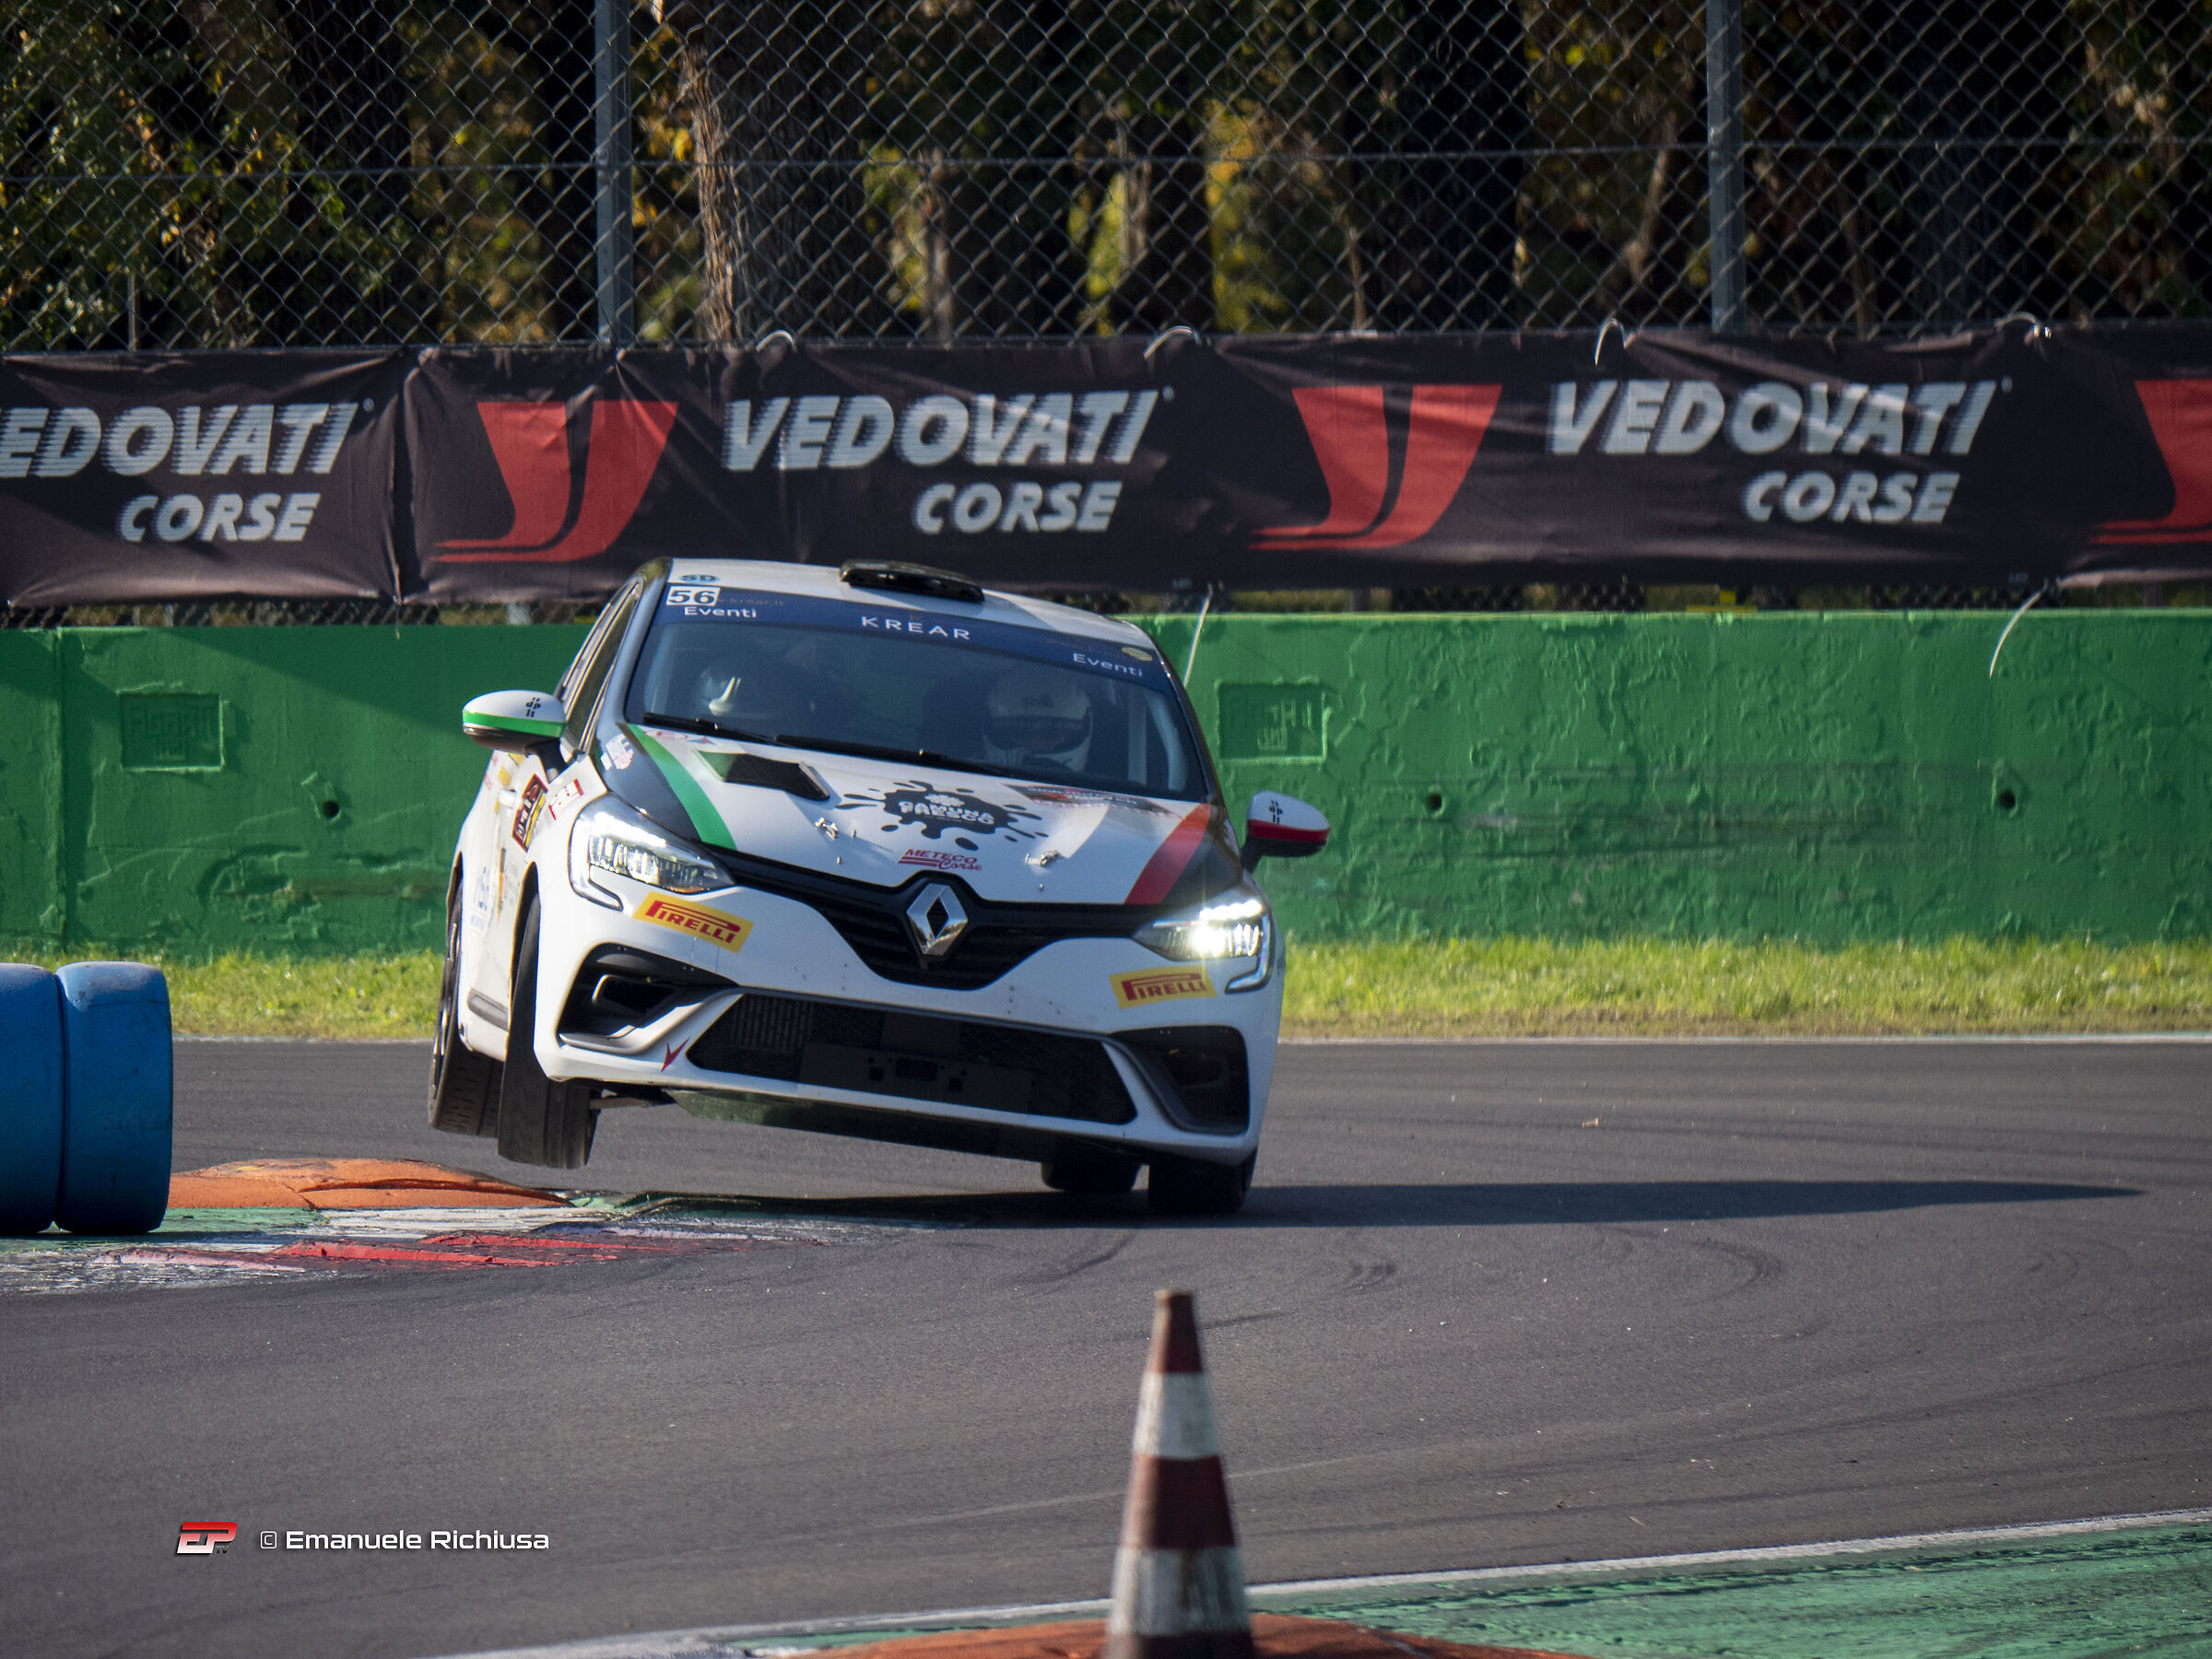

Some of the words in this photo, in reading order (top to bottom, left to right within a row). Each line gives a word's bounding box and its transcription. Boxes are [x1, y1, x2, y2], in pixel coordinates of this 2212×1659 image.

[722, 389, 1159, 471] VEDOVATI
[1545, 379, 1997, 456] VEDOVATI
[0, 403, 359, 477] EDOVATI
[116, 493, 321, 543] CORSE
[912, 481, 1123, 534] CORSE
[1743, 471, 1960, 524] CORSE
[668, 590, 715, 605] 56
[684, 606, 757, 618] Eventi
[861, 616, 971, 640] KREAR
[1073, 653, 1143, 677] Eventi
[905, 849, 978, 864] METECO
[645, 900, 741, 944] PIRELLI
[1121, 972, 1207, 1001] PIRELLI
